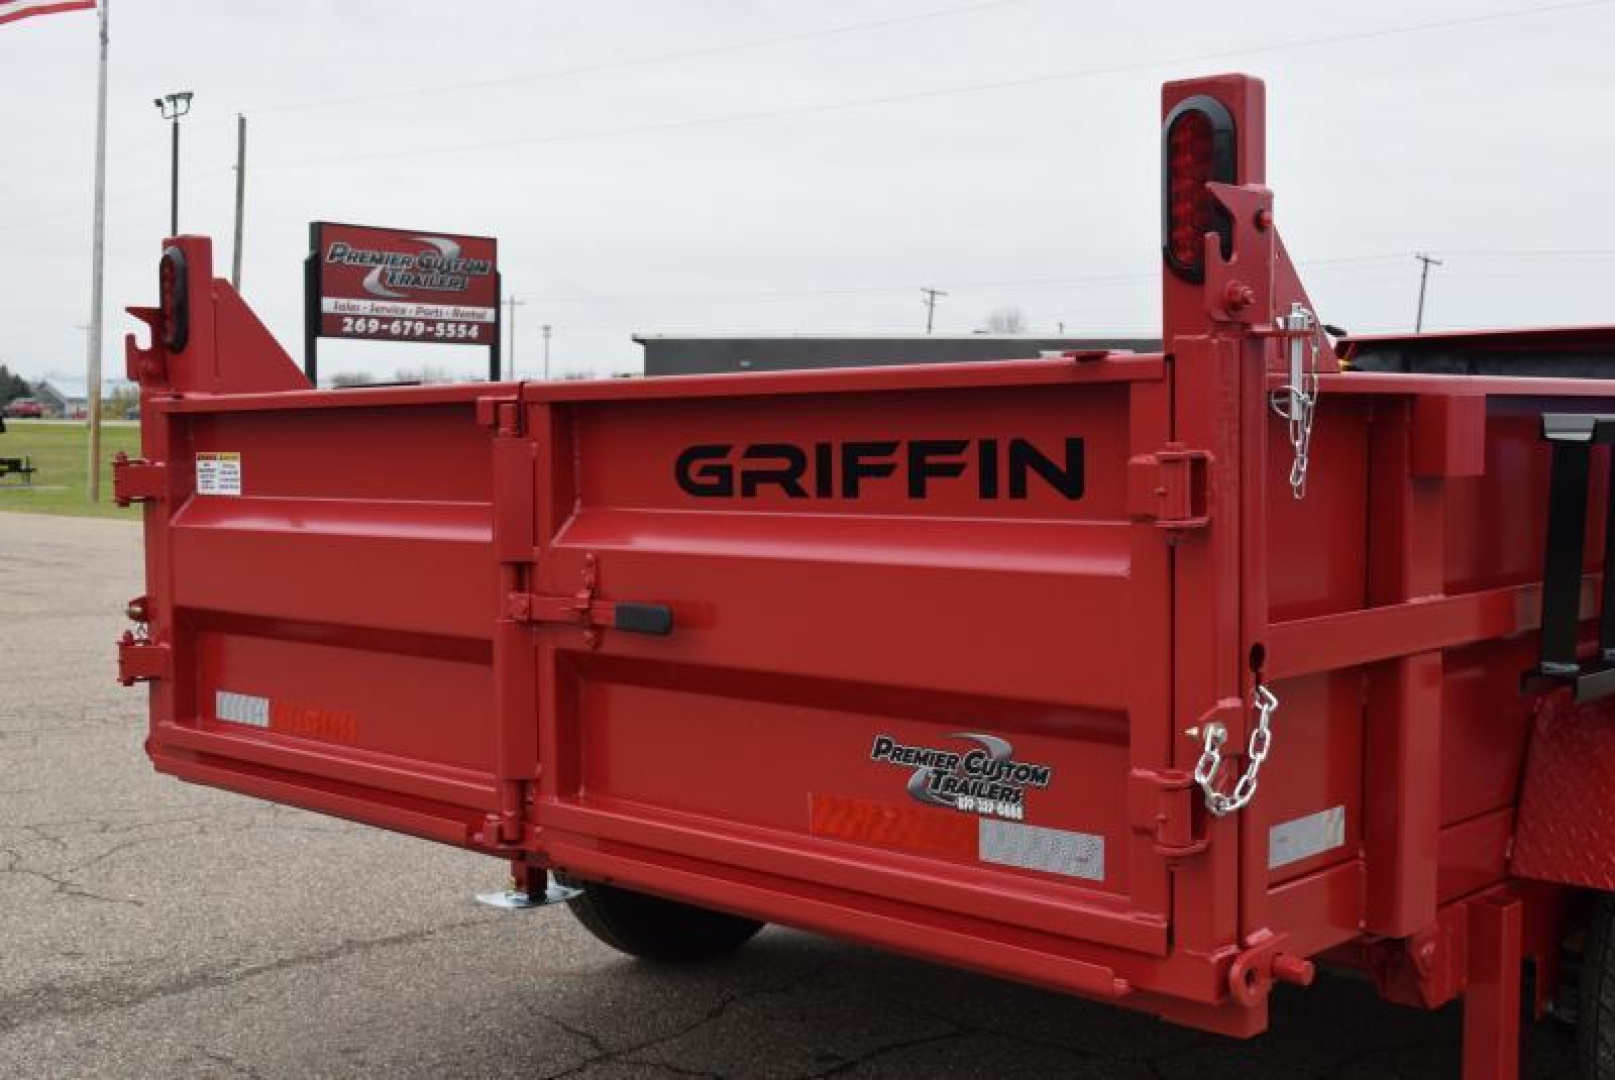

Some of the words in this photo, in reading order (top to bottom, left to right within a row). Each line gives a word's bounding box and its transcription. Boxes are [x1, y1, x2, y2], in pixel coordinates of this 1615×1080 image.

[325, 242, 415, 269] PREMIER
[417, 250, 492, 275] CUSTOM
[386, 268, 468, 291] TRAILERS
[333, 300, 360, 312] Sales
[370, 303, 407, 316] Service
[415, 305, 443, 318] Parts
[451, 307, 487, 320] Rental
[342, 317, 480, 338] 269-679-5554
[674, 437, 1085, 500] GRIFFIN
[872, 735, 960, 769] PREMIER
[963, 749, 1050, 786] CUSTOM
[927, 769, 1024, 804] TRAILERS
